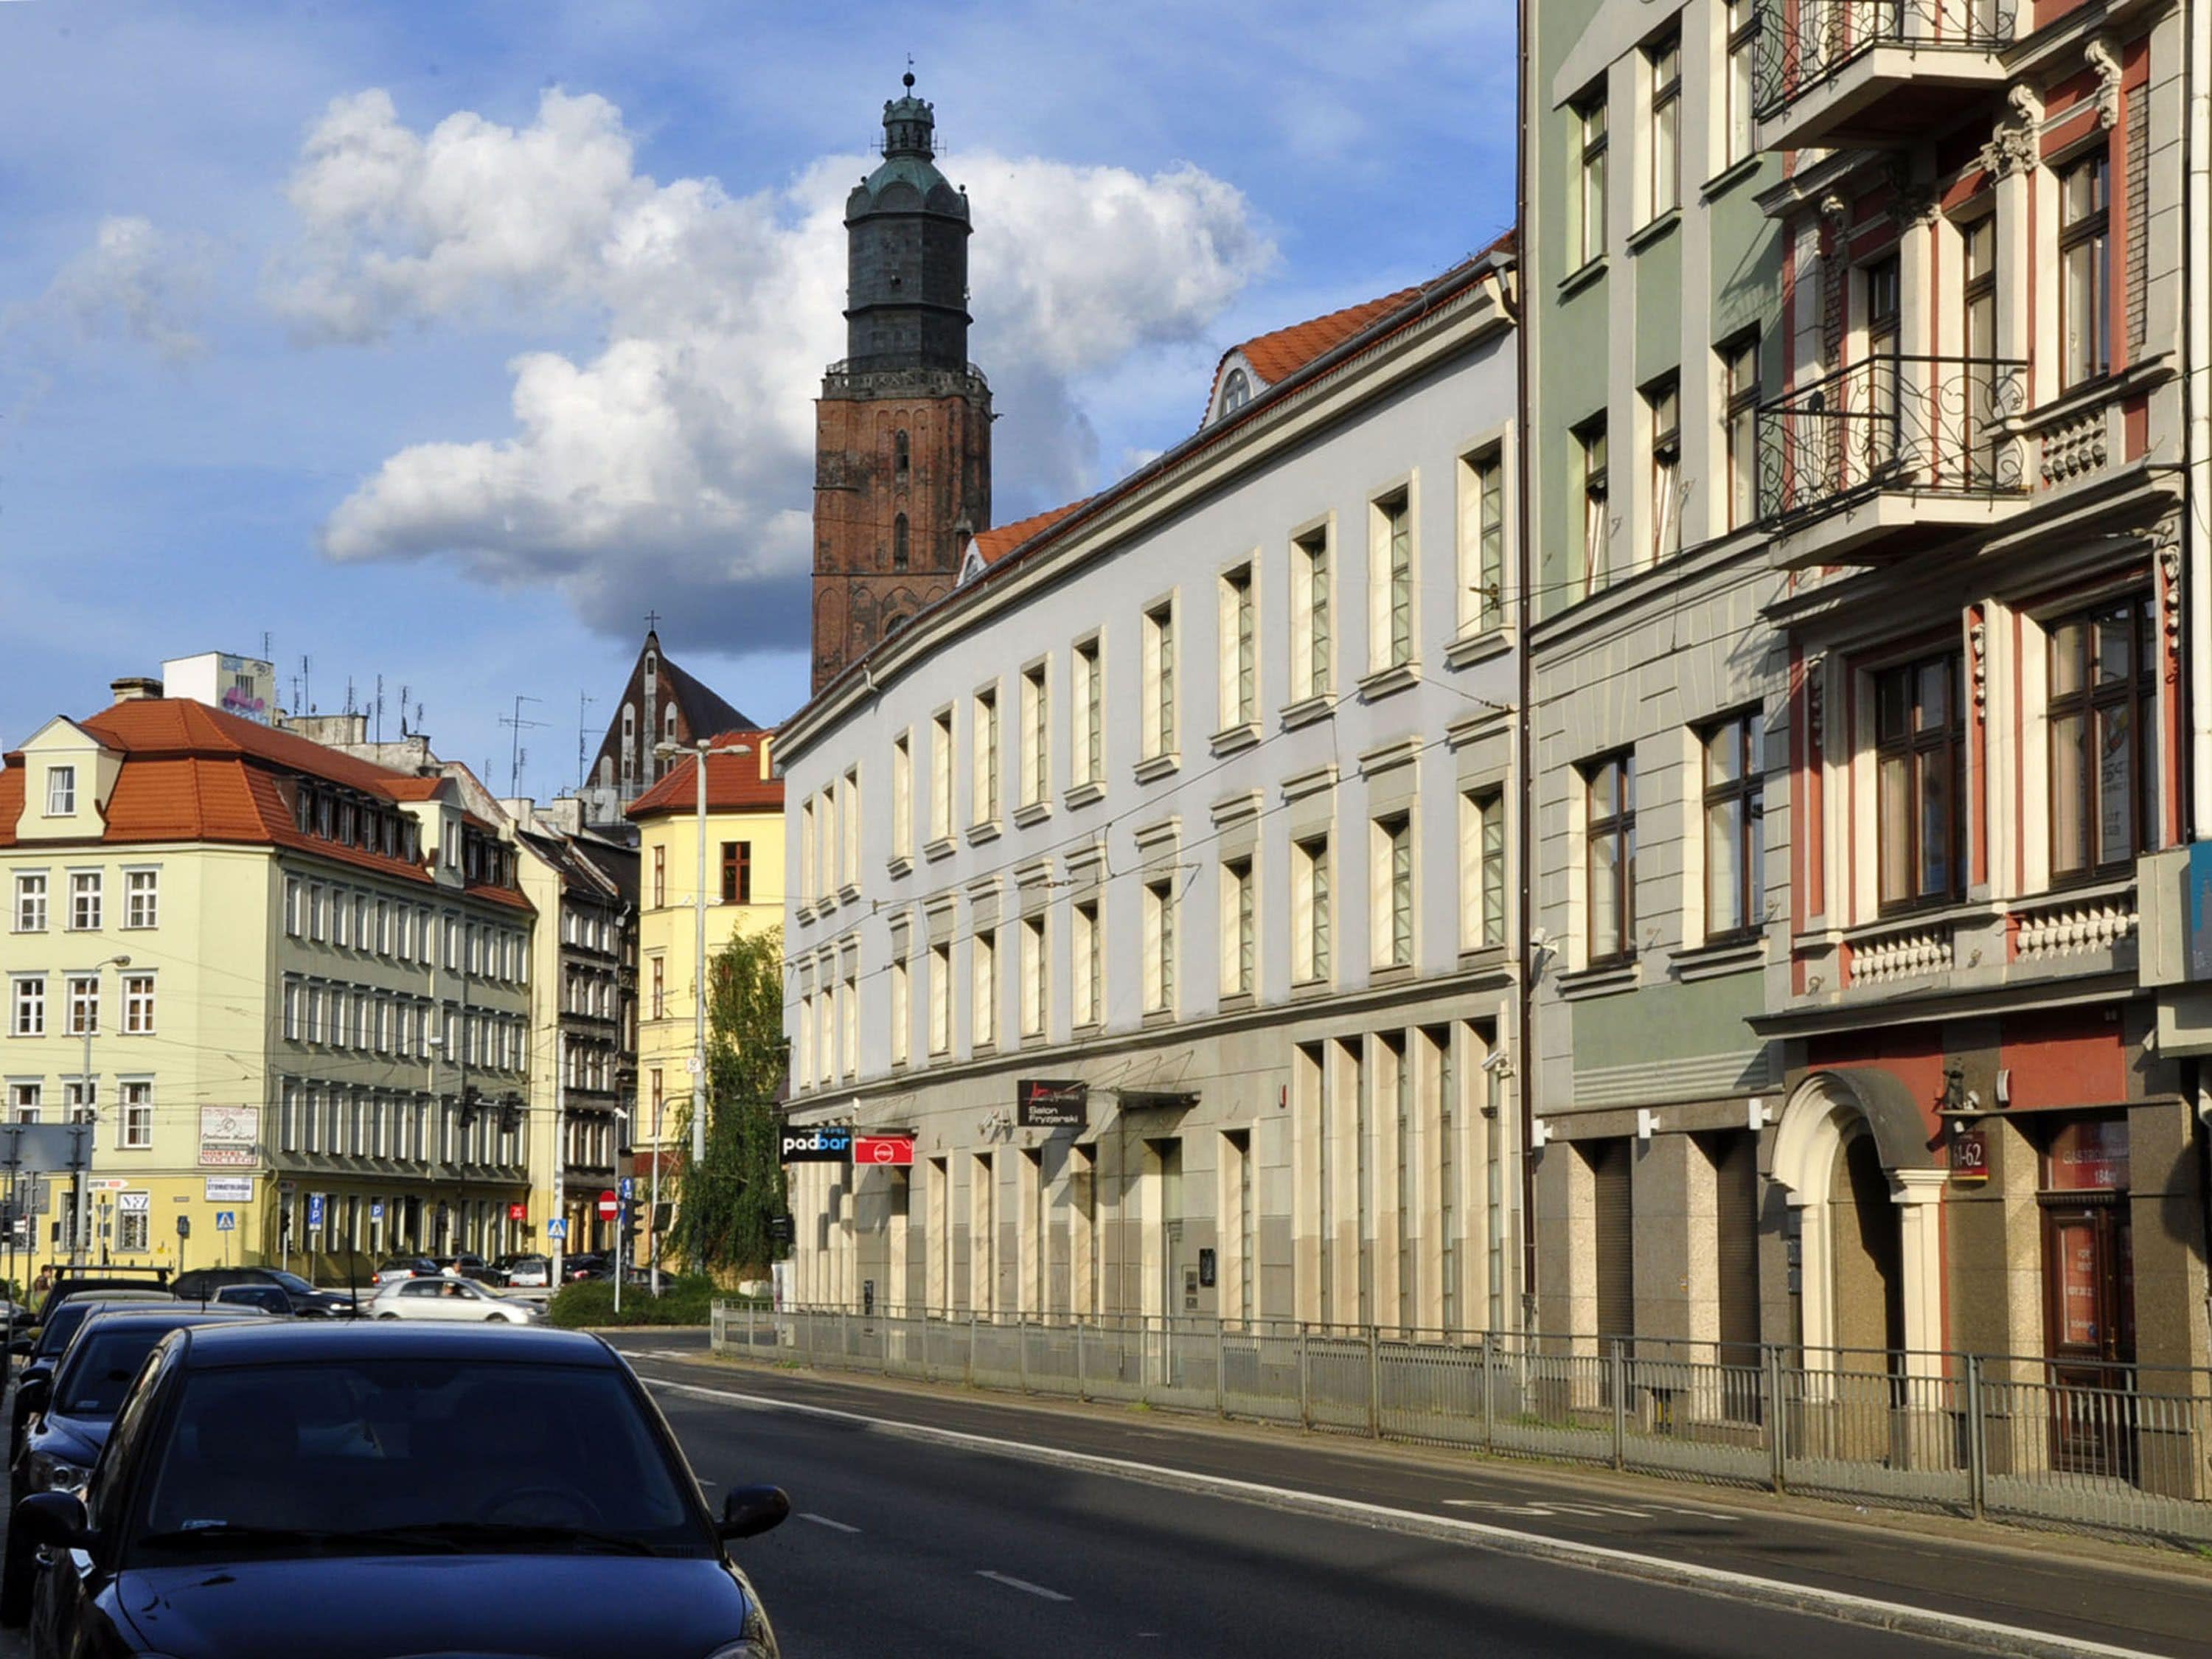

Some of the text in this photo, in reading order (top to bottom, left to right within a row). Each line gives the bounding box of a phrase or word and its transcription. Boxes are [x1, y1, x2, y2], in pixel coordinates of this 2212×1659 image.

[1028, 1106, 1058, 1114] Salon
[1028, 1114, 1079, 1124] Fryzjerski
[783, 1133, 849, 1155] padbar
[312, 1210, 321, 1220] P
[372, 1206, 381, 1216] P
